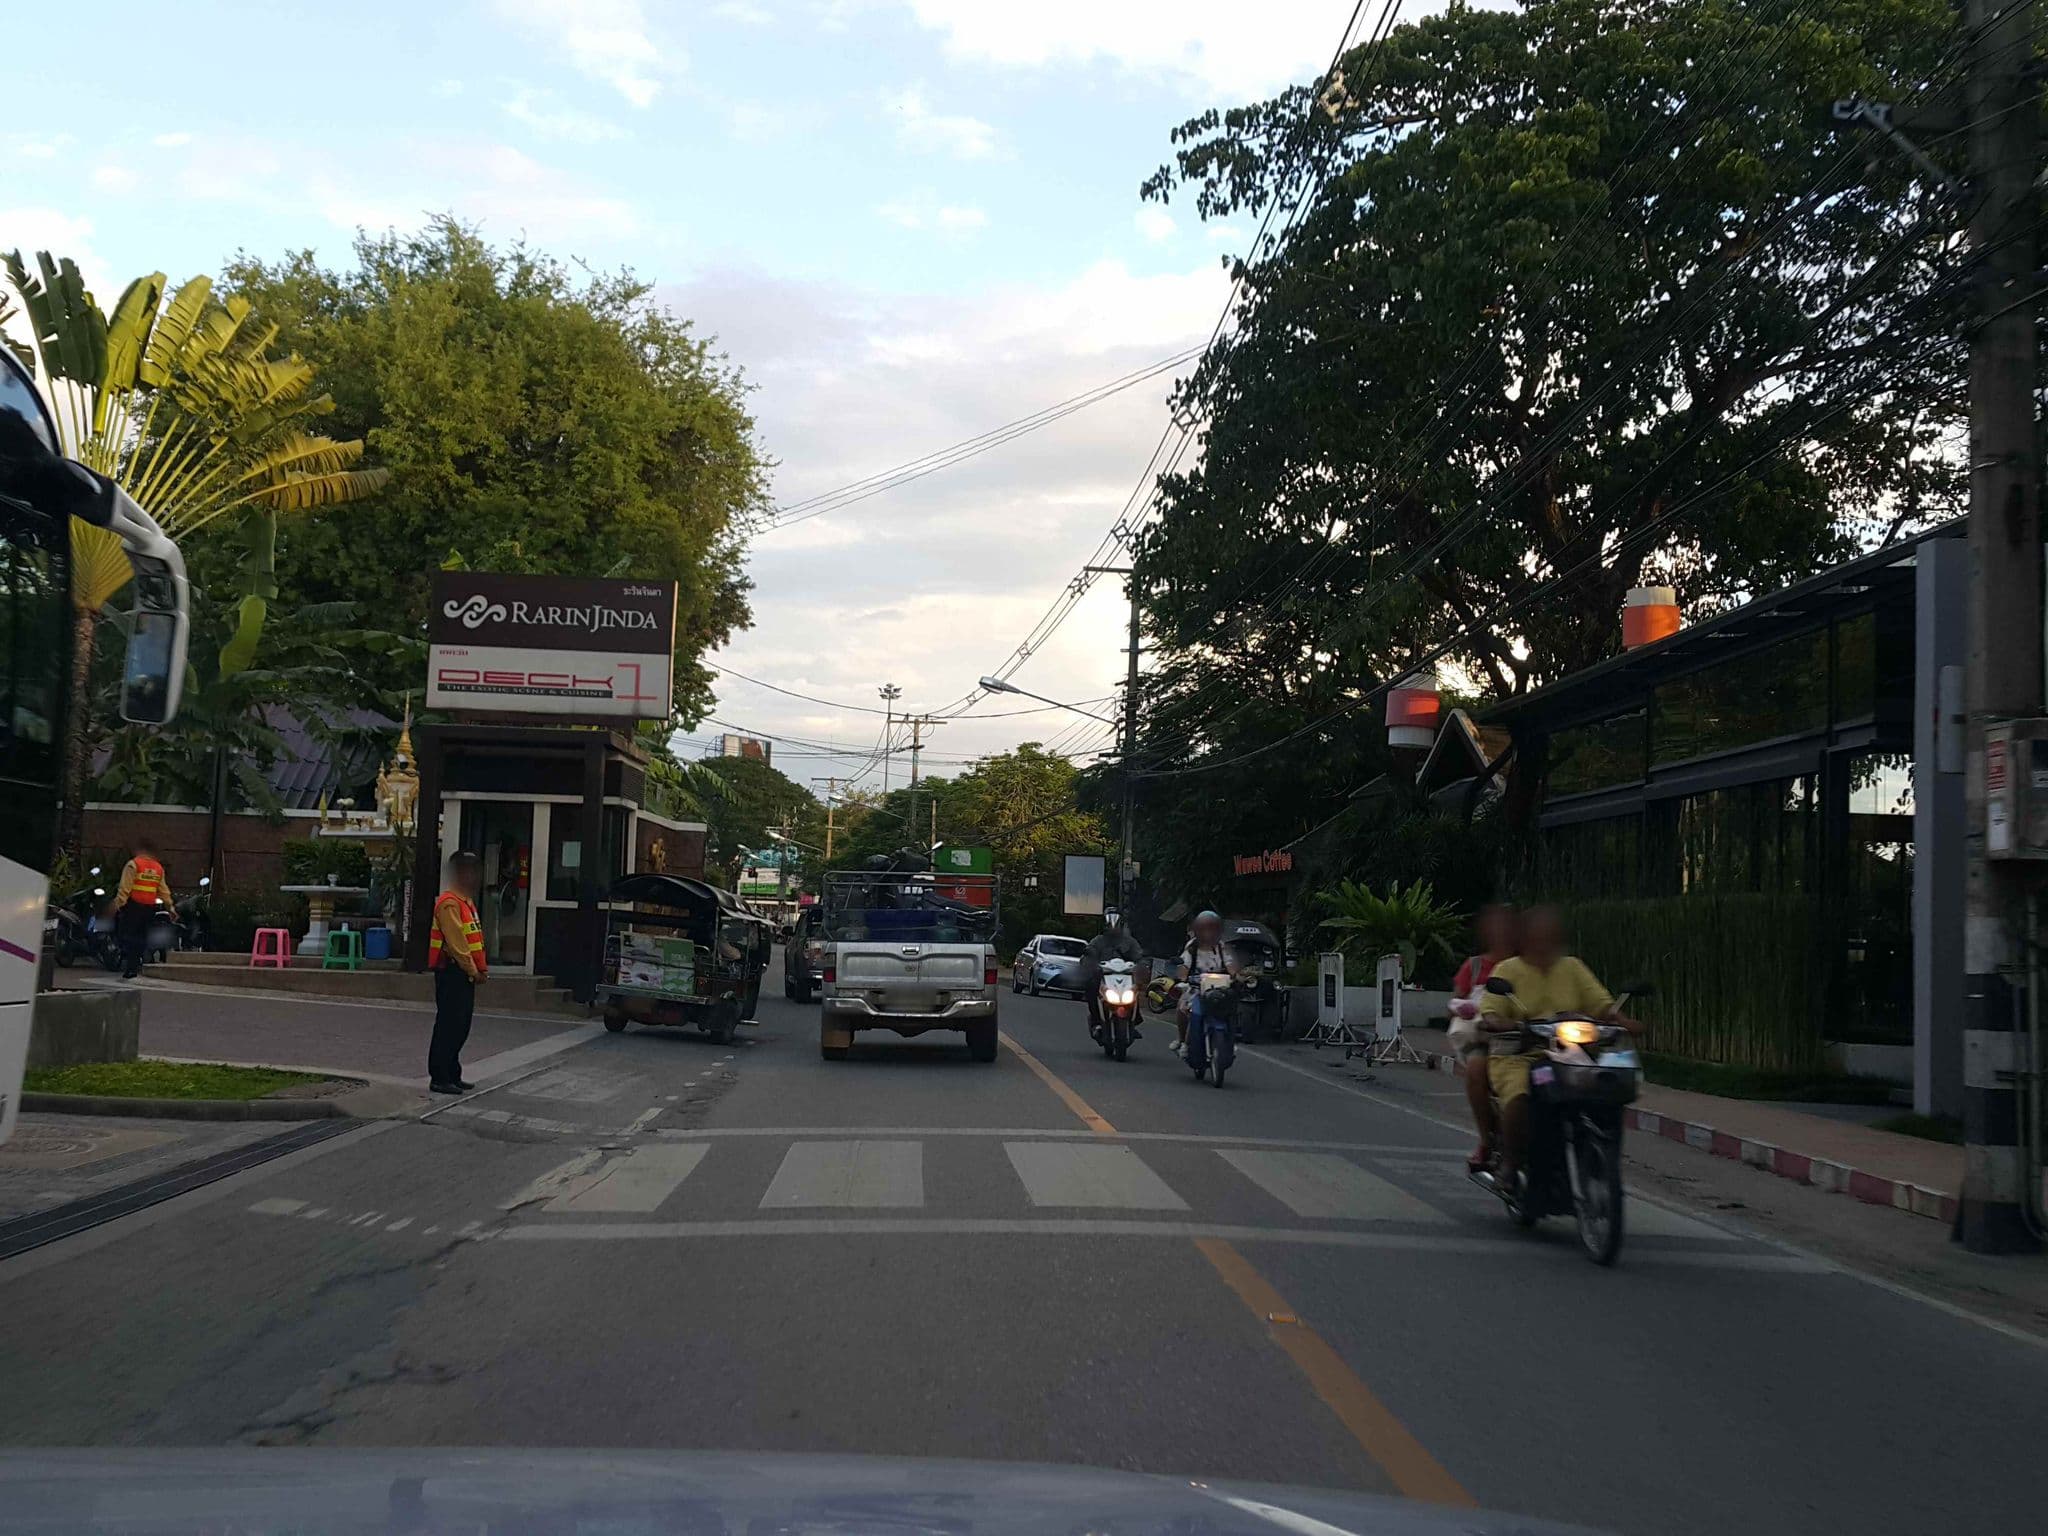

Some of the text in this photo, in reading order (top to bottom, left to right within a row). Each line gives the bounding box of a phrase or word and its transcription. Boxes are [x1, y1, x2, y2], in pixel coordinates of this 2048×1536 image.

[438, 663, 657, 701] DECK 1
[1263, 849, 1291, 872] Coffee
